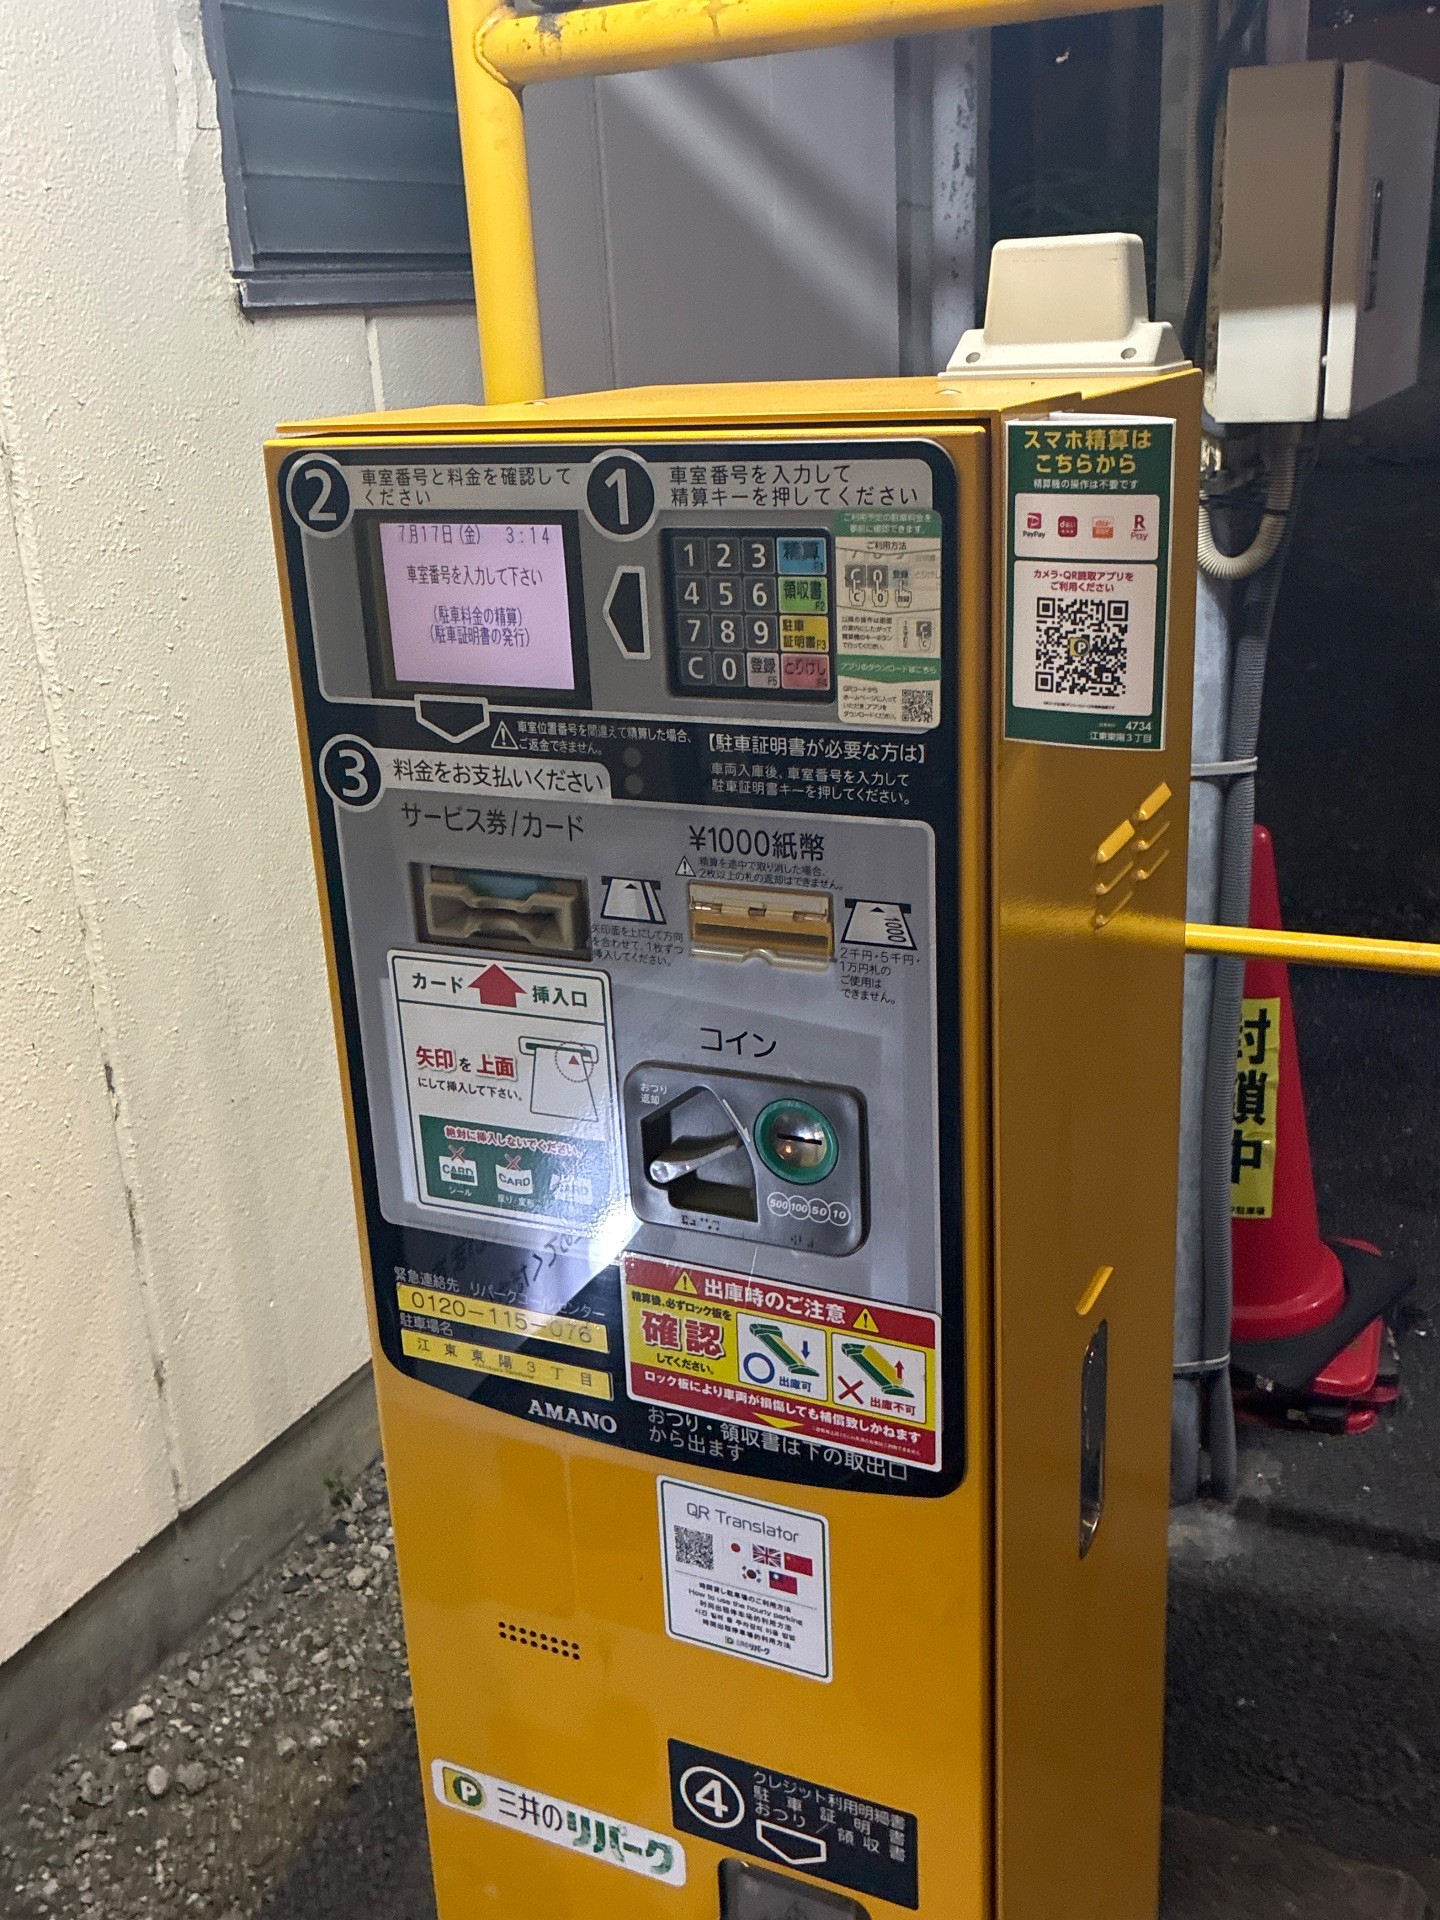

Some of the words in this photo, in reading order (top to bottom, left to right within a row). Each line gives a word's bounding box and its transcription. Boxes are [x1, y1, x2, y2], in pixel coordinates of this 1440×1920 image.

[1024, 429, 1152, 450] スマホ精算は
[670, 464, 850, 486] 車室番号を入力して
[1036, 454, 1137, 474] こちらから
[361, 467, 571, 488] 車室番号と料金を確認して
[1033, 479, 1138, 489] 精算機の操作は不要です
[305, 468, 337, 521] 2
[364, 488, 431, 507] ください
[605, 467, 629, 526] 1
[670, 486, 918, 508] 精算キーを押してください
[506, 526, 550, 544] 3:14
[867, 541, 907, 550] ご利用方法
[1023, 530, 1046, 539] PayPay
[684, 543, 694, 567] 1
[716, 543, 732, 567] 2
[751, 543, 766, 568] 3
[407, 565, 543, 586] 車室番号を入力して下さい
[1034, 569, 1134, 581] カメラ・QR読取アプリを
[1051, 582, 1114, 592] ご利用ください
[684, 581, 699, 605] 4
[719, 582, 733, 606] 5
[752, 582, 767, 606] 6
[784, 580, 822, 599] 領収書
[433, 605, 522, 627] (駐車料金の精算)
[815, 602, 825, 611] F2
[431, 624, 530, 647] (駐車証明書の発行)
[687, 619, 701, 642] 7
[720, 619, 735, 643] 8
[753, 620, 769, 644] 9
[782, 619, 805, 631] 駐車
[783, 635, 815, 648] 証明書
[816, 641, 827, 650] F3
[688, 656, 704, 679] C
[722, 657, 737, 681] 0
[751, 657, 776, 674] 登録
[785, 658, 826, 675] とりけし
[767, 677, 778, 686] F5
[1125, 721, 1153, 731] 4734
[518, 738, 603, 756] ご返金できません。
[709, 733, 925, 764] 【駐車証明書が必要な方は】
[338, 749, 369, 799] 3
[393, 758, 604, 795] 料金をお支払いください
[710, 762, 910, 787] 車両入庫後、車室番号を入力して
[711, 778, 911, 805] 駐車証明書キーを押してください。
[401, 802, 585, 842] サービス券/カード
[689, 825, 825, 862] ¥1000紙幣
[884, 917, 906, 944] 1000
[840, 961, 891, 976] 1万円札の
[412, 972, 464, 993] カード
[532, 985, 588, 1008] 挿入口
[841, 974, 882, 989] ご使用は
[842, 989, 896, 1005] できません。
[700, 1027, 777, 1058] コイン
[418, 1077, 523, 1101] にして挿入して下さい。
[641, 1083, 667, 1094] おつり
[499, 1173, 530, 1187] CARD
[770, 1199, 788, 1210] 500
[790, 1203, 808, 1213] 100
[812, 1206, 828, 1216] 50
[833, 1210, 847, 1220] 10
[394, 1266, 460, 1293] 緊急連絡先
[704, 1278, 846, 1324] 出庫時のご注意
[400, 1313, 453, 1337] 駐車場名
[412, 1291, 593, 1344] 0120-115-076
[642, 1310, 725, 1359] 確認
[657, 1353, 714, 1375] してください。
[779, 1375, 812, 1393] 出庫可
[528, 1399, 618, 1433] AMANO
[644, 1370, 921, 1444] ロック板により車両が損傷しても補償致しかねます
[870, 1396, 916, 1416] 出庫不可
[648, 1406, 908, 1480] おつり・領収書は下の取出口
[649, 1425, 745, 1462] から出ます
[687, 1502, 710, 1520] QR
[715, 1509, 799, 1543] Translator
[688, 1588, 706, 1598] How
[717, 1597, 731, 1605] use
[733, 1601, 745, 1609] the
[747, 1604, 771, 1617] hourly
[773, 1612, 803, 1626] parking
[695, 1781, 730, 1818] 4
[753, 1771, 906, 1831] クレジット利用明細書
[498, 1787, 674, 1875] 三井のリパーク
